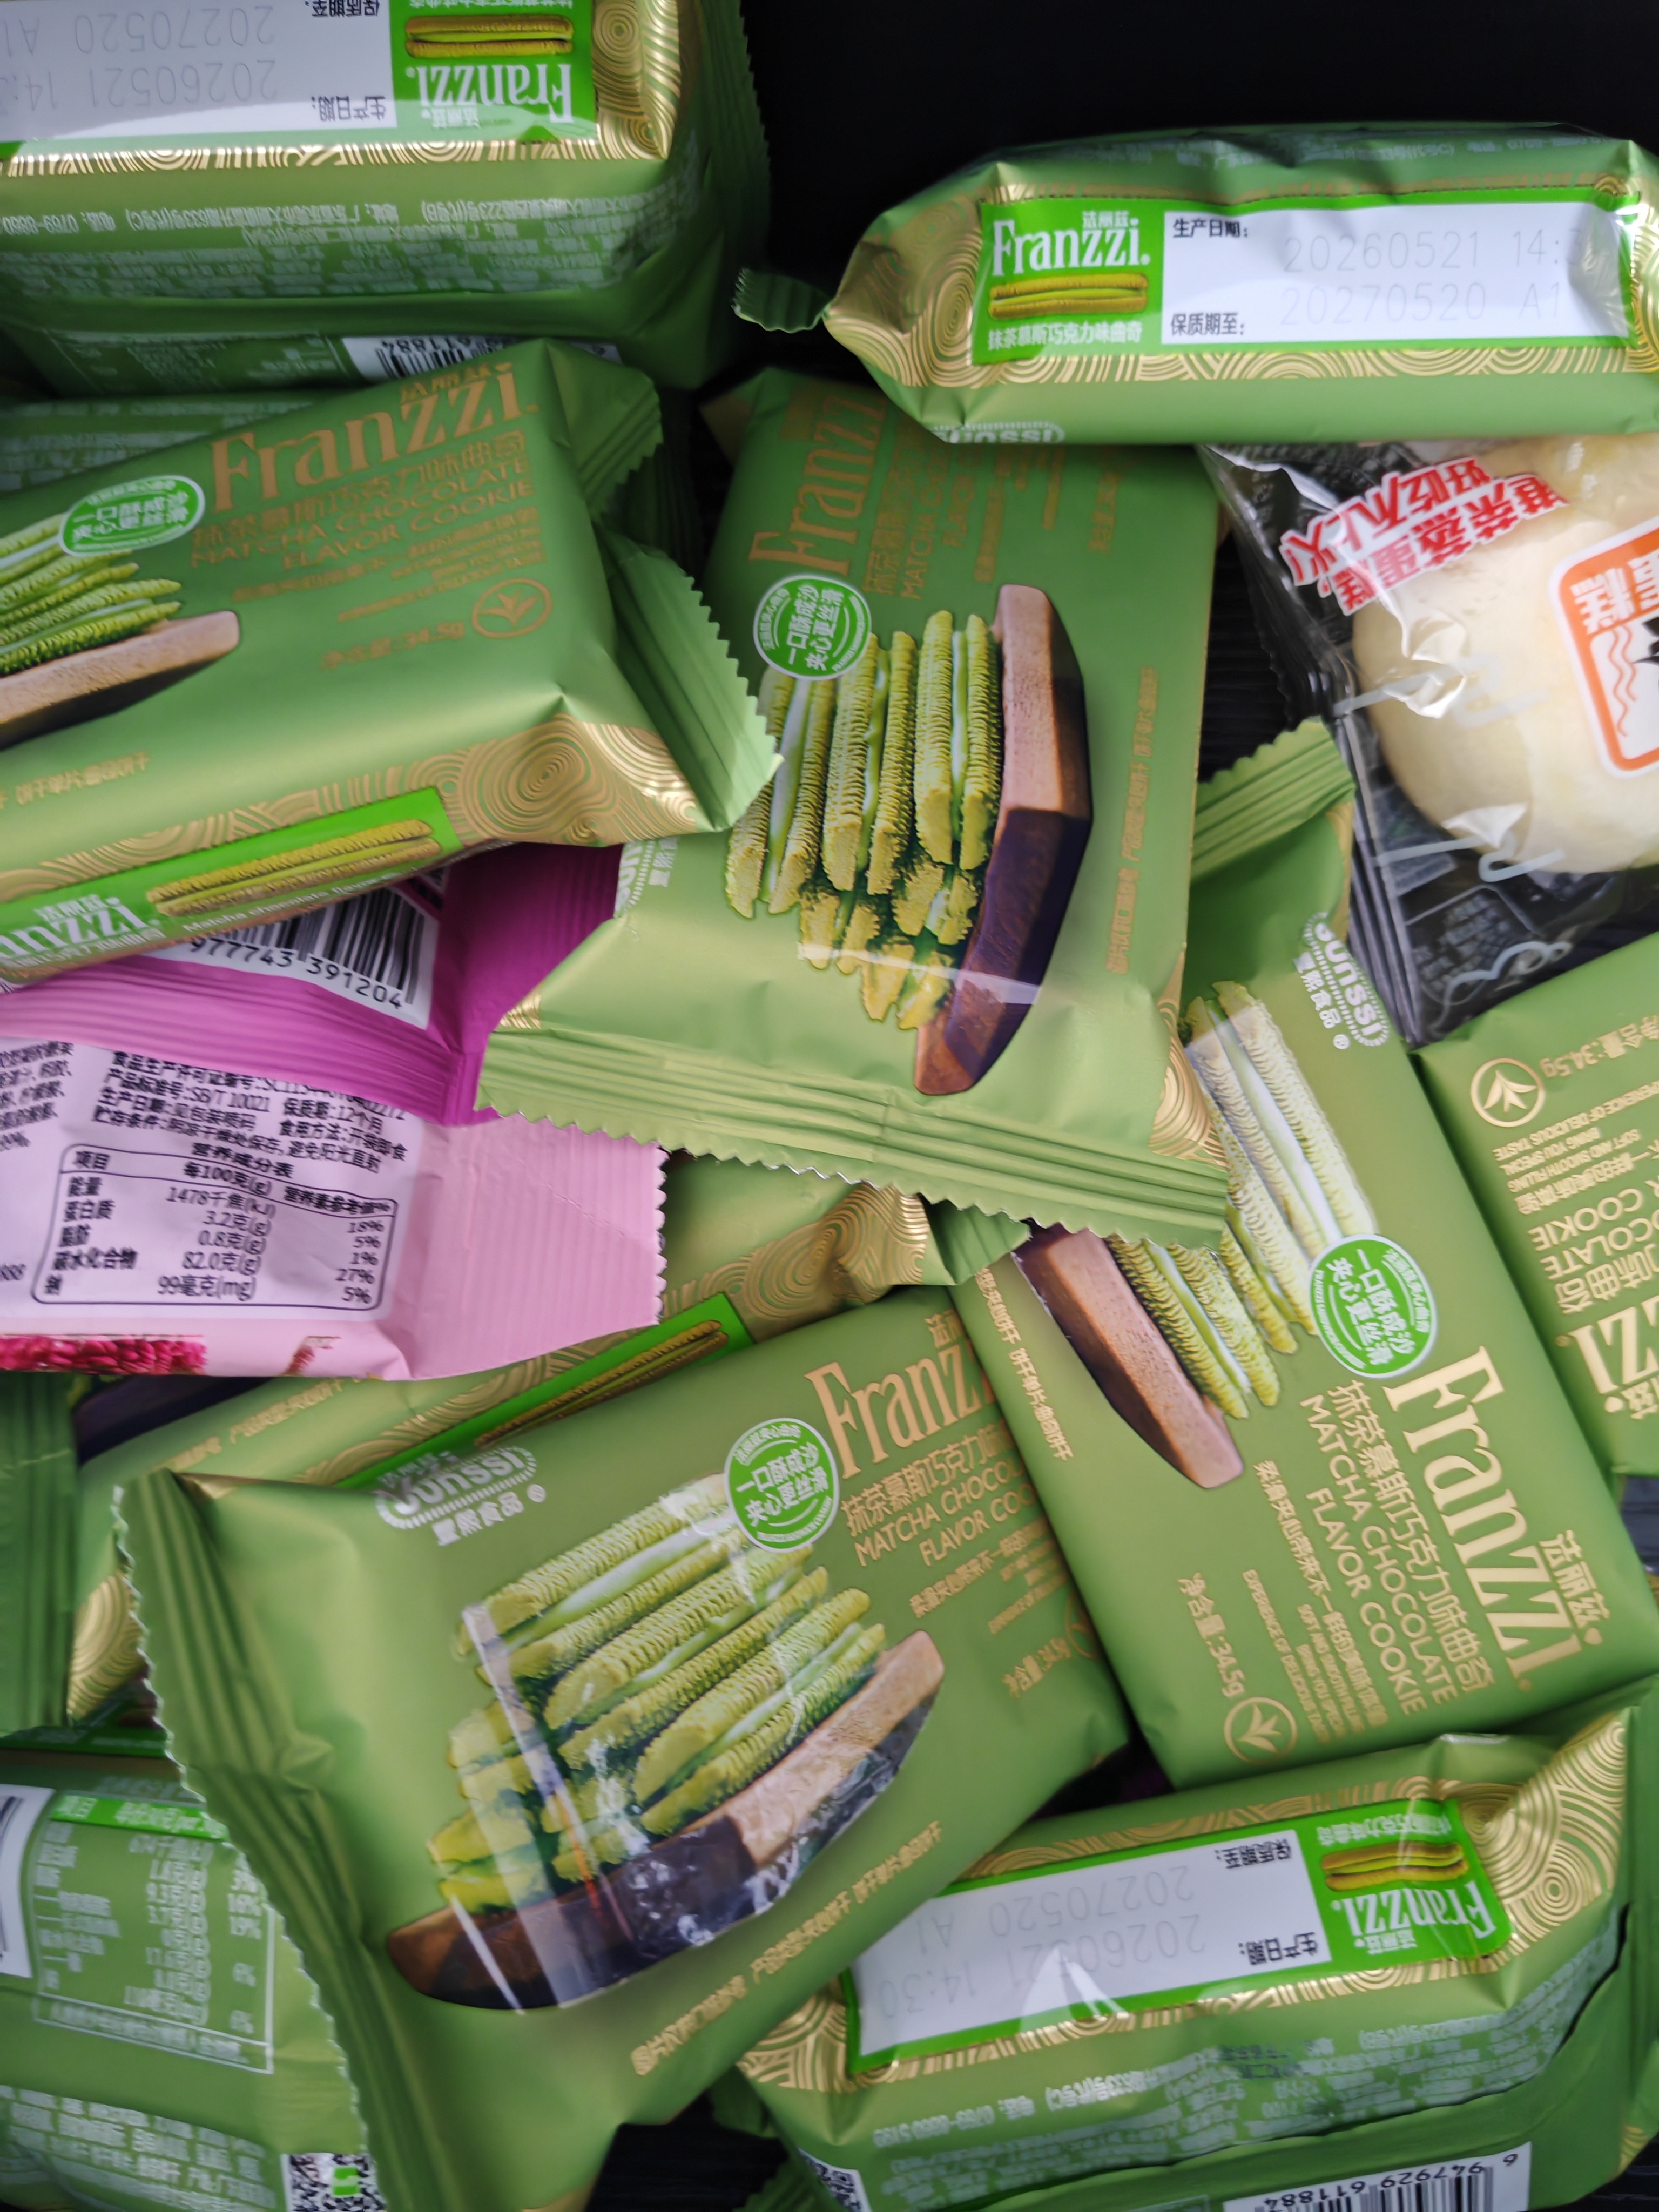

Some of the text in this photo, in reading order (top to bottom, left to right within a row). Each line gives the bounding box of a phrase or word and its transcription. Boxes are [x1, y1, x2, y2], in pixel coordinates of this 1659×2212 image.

[73, 5, 273, 53] 20270520
[87, 59, 276, 108] 20260521
[1172, 214, 1248, 241] 生产日期:
[1282, 226, 1479, 276] 20260521
[1170, 309, 1245, 340] 保质期至:
[1278, 277, 1489, 331] 20270520
[335, 456, 530, 534] CHOCOLATE
[407, 477, 535, 534] COOKIE
[306, 956, 403, 1009] 391204
[1492, 1136, 1532, 1162] TASTE
[1499, 1126, 1600, 1176] BRING YOU SPECIAL
[1528, 1111, 1590, 1145] DELICIOUS
[73, 1150, 111, 1172] 项目
[191, 1143, 294, 1179] 营养成分表
[1506, 1128, 1641, 1193] SOFT AND SMOOTH FILLING
[66, 1174, 103, 1201] 能量
[63, 1195, 115, 1228] 蛋白质
[353, 1233, 382, 1251] 5%
[1527, 1184, 1644, 1251] COOKIE
[52, 1239, 139, 1281] 碳水化合物
[334, 1266, 376, 1287] 27%
[349, 1250, 379, 1268] 1%
[156, 1265, 258, 1307] 99毫克(mg)
[341, 1286, 372, 1305] 5%
[1357, 1247, 1417, 1357] 一口酥成沙
[1325, 1257, 1394, 1367] 夹心更丝滑
[854, 1501, 940, 1566] MATCHA
[918, 1508, 989, 1566] FLAVOR
[1326, 1378, 1496, 1695] 抹茶慕斯巧克力味曲奇
[1381, 1345, 1603, 1681] Franzzi
[1299, 1394, 1456, 1705] MATCHA CHOCOLATE
[1297, 1603, 1321, 1633] SOFT
[1305, 1487, 1427, 1717] FLAVOR COOKIE
[1177, 1571, 1250, 1700] 净含量:34.5g
[1272, 1636, 1292, 1656] OF
[1309, 1630, 1331, 1655] AND
[1319, 1653, 1350, 1698] SMOOTH
[1213, 1836, 1292, 1871] 保质期至:
[986, 1864, 1194, 1938] 20270520
[1236, 1930, 1319, 1968] 生产日期:
[1262, 2179, 1366, 2209] 611884
[1379, 2161, 1484, 2189] 947929
